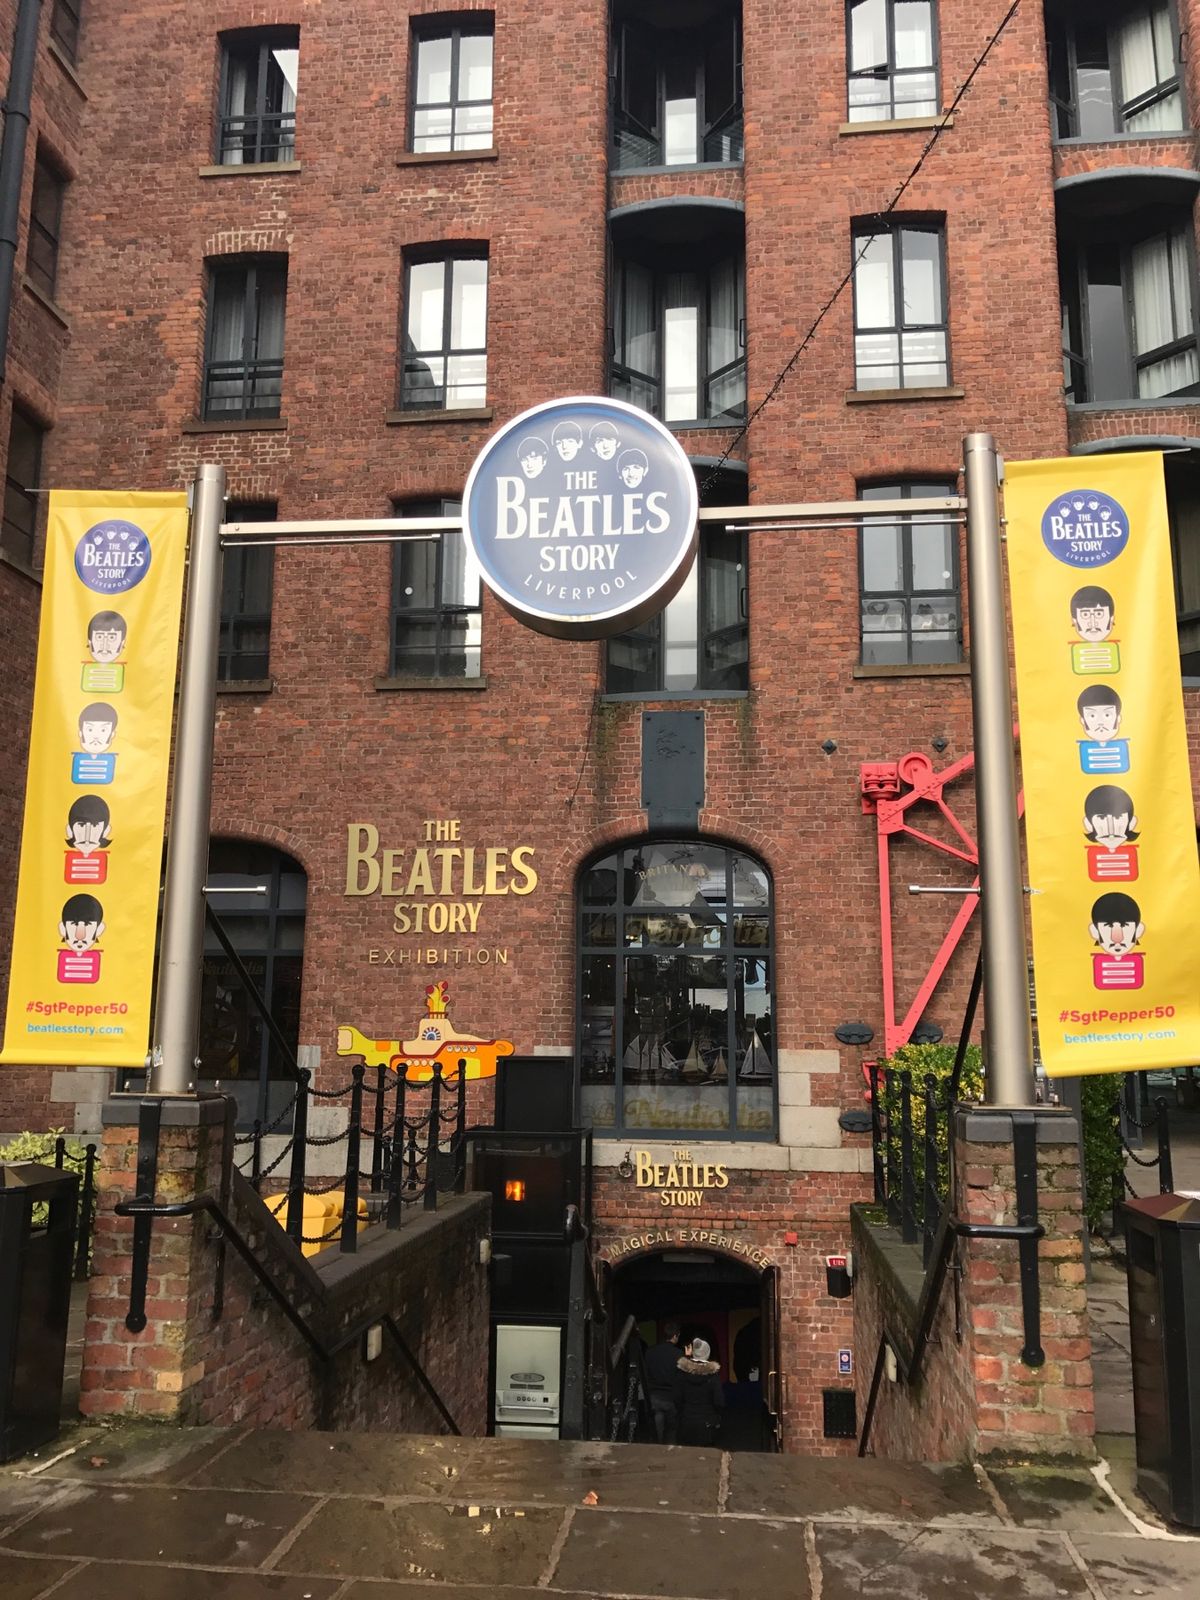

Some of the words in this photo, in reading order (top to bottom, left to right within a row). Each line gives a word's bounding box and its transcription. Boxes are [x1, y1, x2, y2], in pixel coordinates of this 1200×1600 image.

[564, 471, 598, 490] THE
[494, 476, 671, 539] BEATLES
[1050, 516, 1122, 540] BEATLES
[82, 543, 144, 567] BEATLES
[1070, 540, 1103, 552] STORY
[539, 544, 620, 572] STORY
[1065, 550, 1111, 562] LIVERPOOL
[97, 568, 126, 579] STORY
[524, 570, 638, 600] LIVERPOOL
[423, 820, 461, 841] THE
[344, 823, 538, 896] BEATLES
[393, 903, 483, 933] STORY
[369, 949, 508, 965] EXHIBITION
[26, 1001, 128, 1016] #SgtPepper50
[1059, 1006, 1175, 1025] #SgtPepper50
[27, 1023, 124, 1035] beatlesstory.com
[1064, 1030, 1176, 1044] beatlesstory.com
[672, 1149, 692, 1161] THE
[635, 1150, 729, 1188] BEATLES
[660, 1190, 704, 1206] STORY
[608, 1231, 673, 1258] MAGICAL
[679, 1231, 771, 1270] EXPERIENCE
